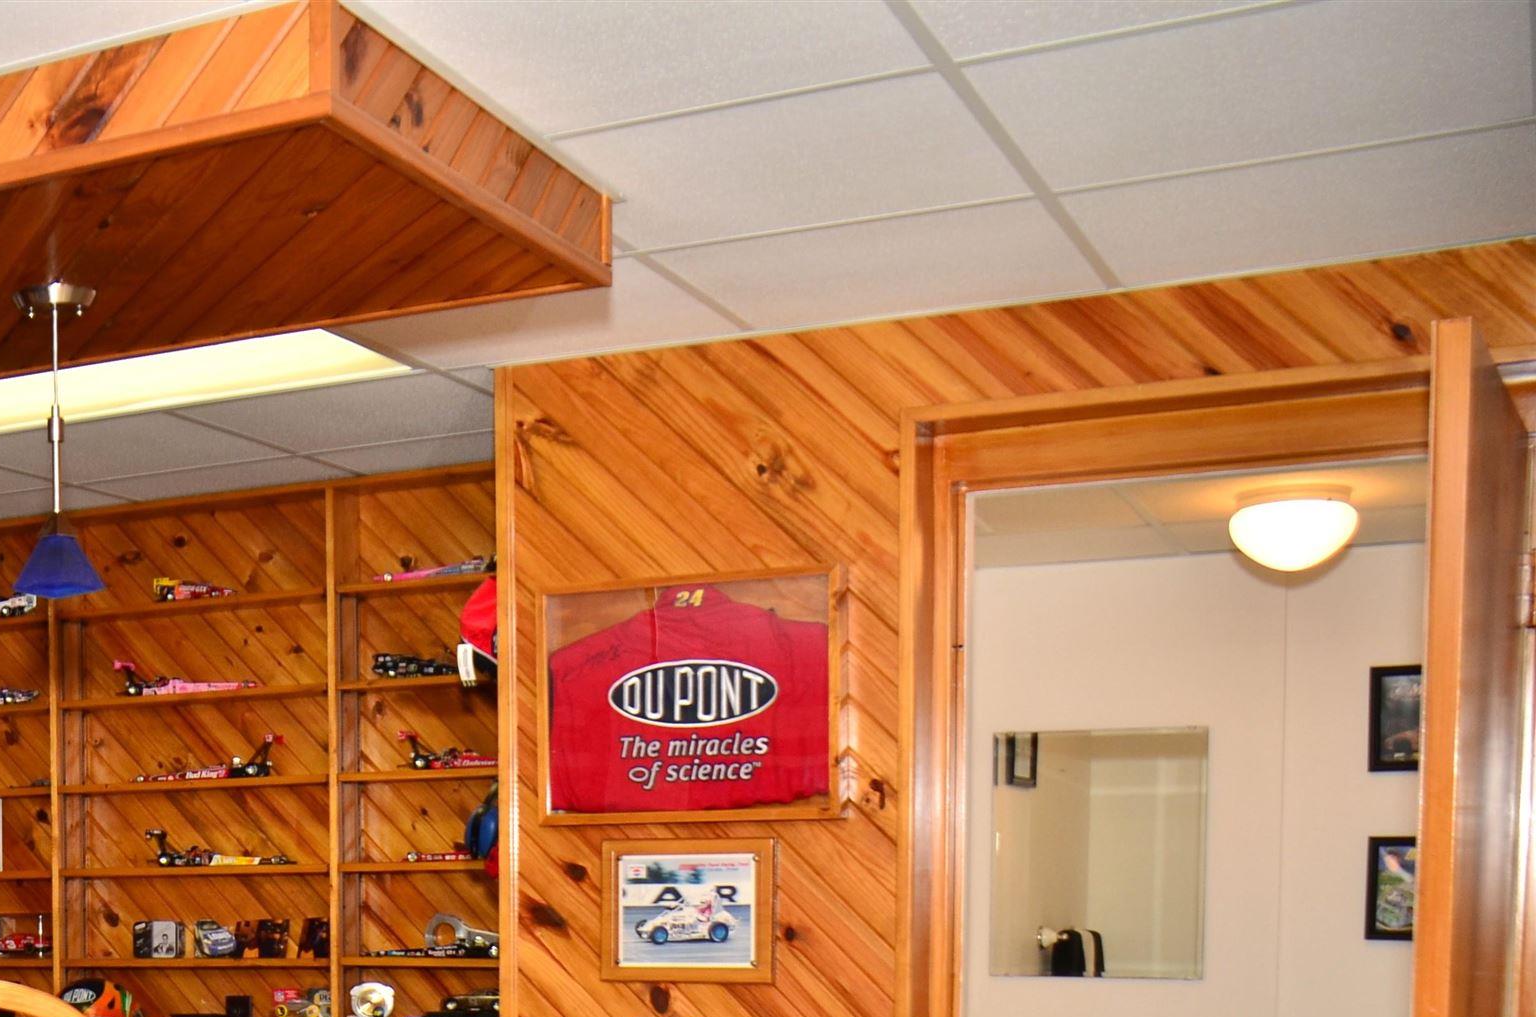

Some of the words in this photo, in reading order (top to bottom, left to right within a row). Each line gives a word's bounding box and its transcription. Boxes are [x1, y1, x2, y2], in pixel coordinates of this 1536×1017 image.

[674, 589, 704, 608] 24
[620, 735, 661, 759] The
[667, 732, 769, 757] miracles
[628, 761, 662, 790] of
